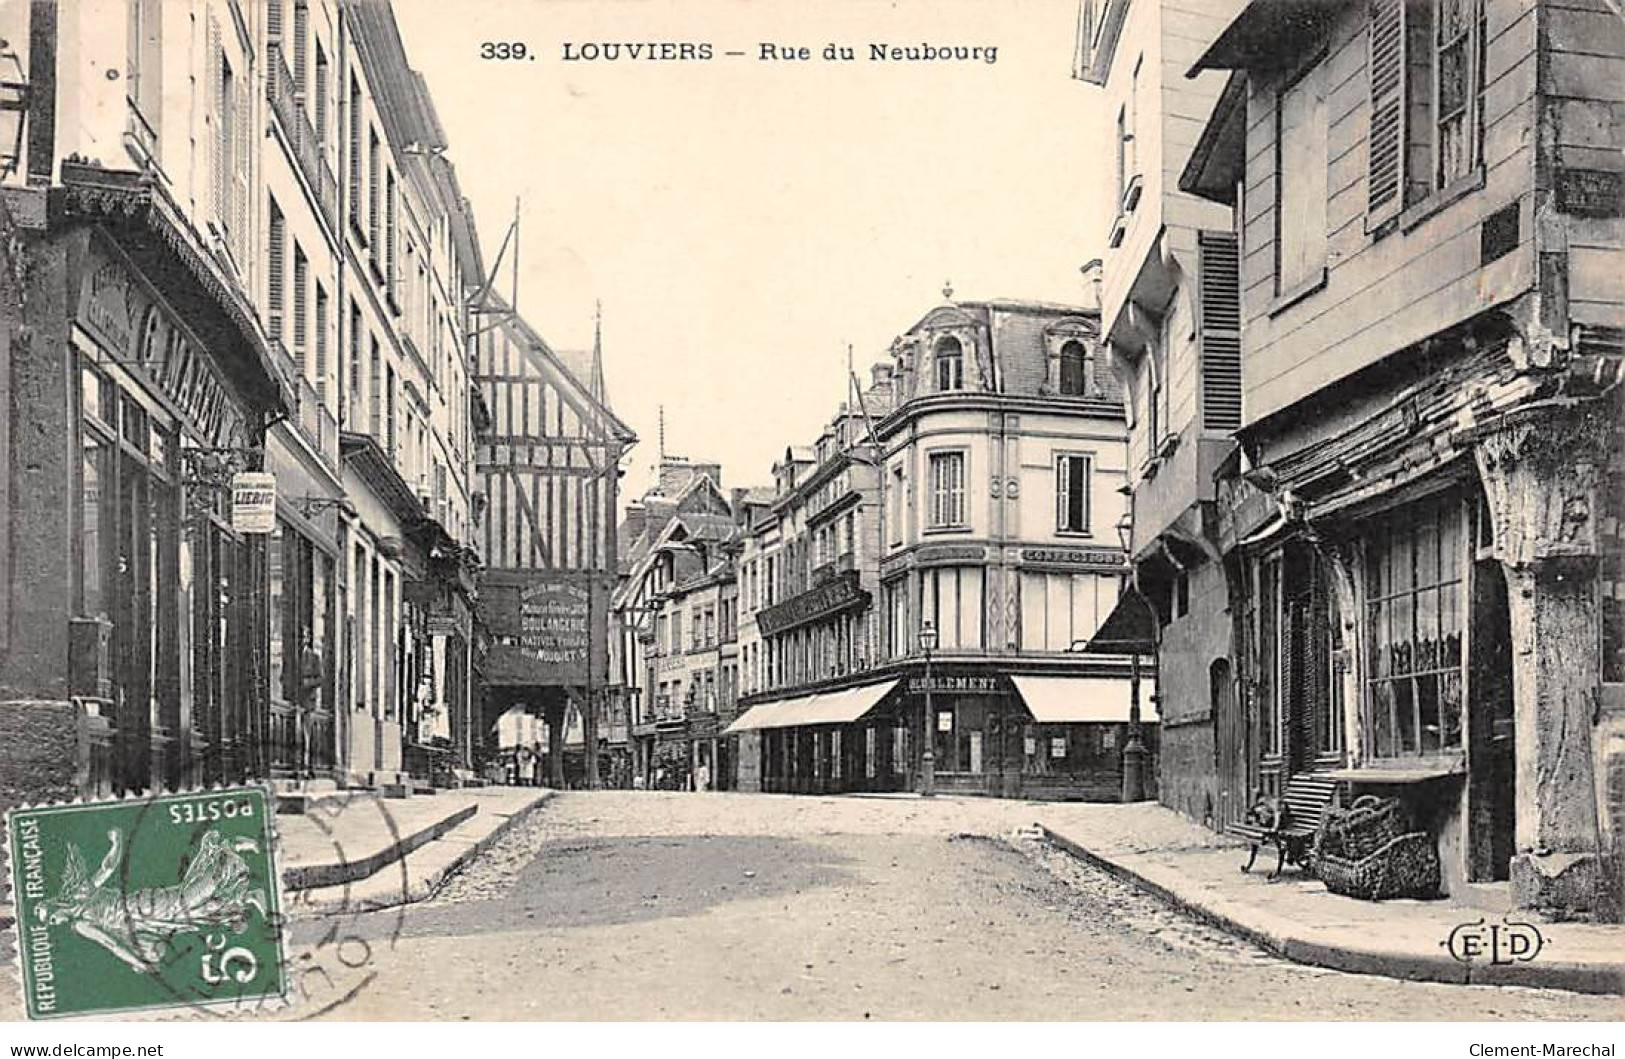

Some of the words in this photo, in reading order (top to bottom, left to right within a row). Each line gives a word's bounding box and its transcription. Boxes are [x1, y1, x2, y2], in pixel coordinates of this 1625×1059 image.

[521, 617, 587, 632] BOULANGERIE
[169, 797, 253, 824] POSTES
[20, 818, 44, 899] FRANÇAISE
[30, 925, 56, 1012] REPUBLIQUE
